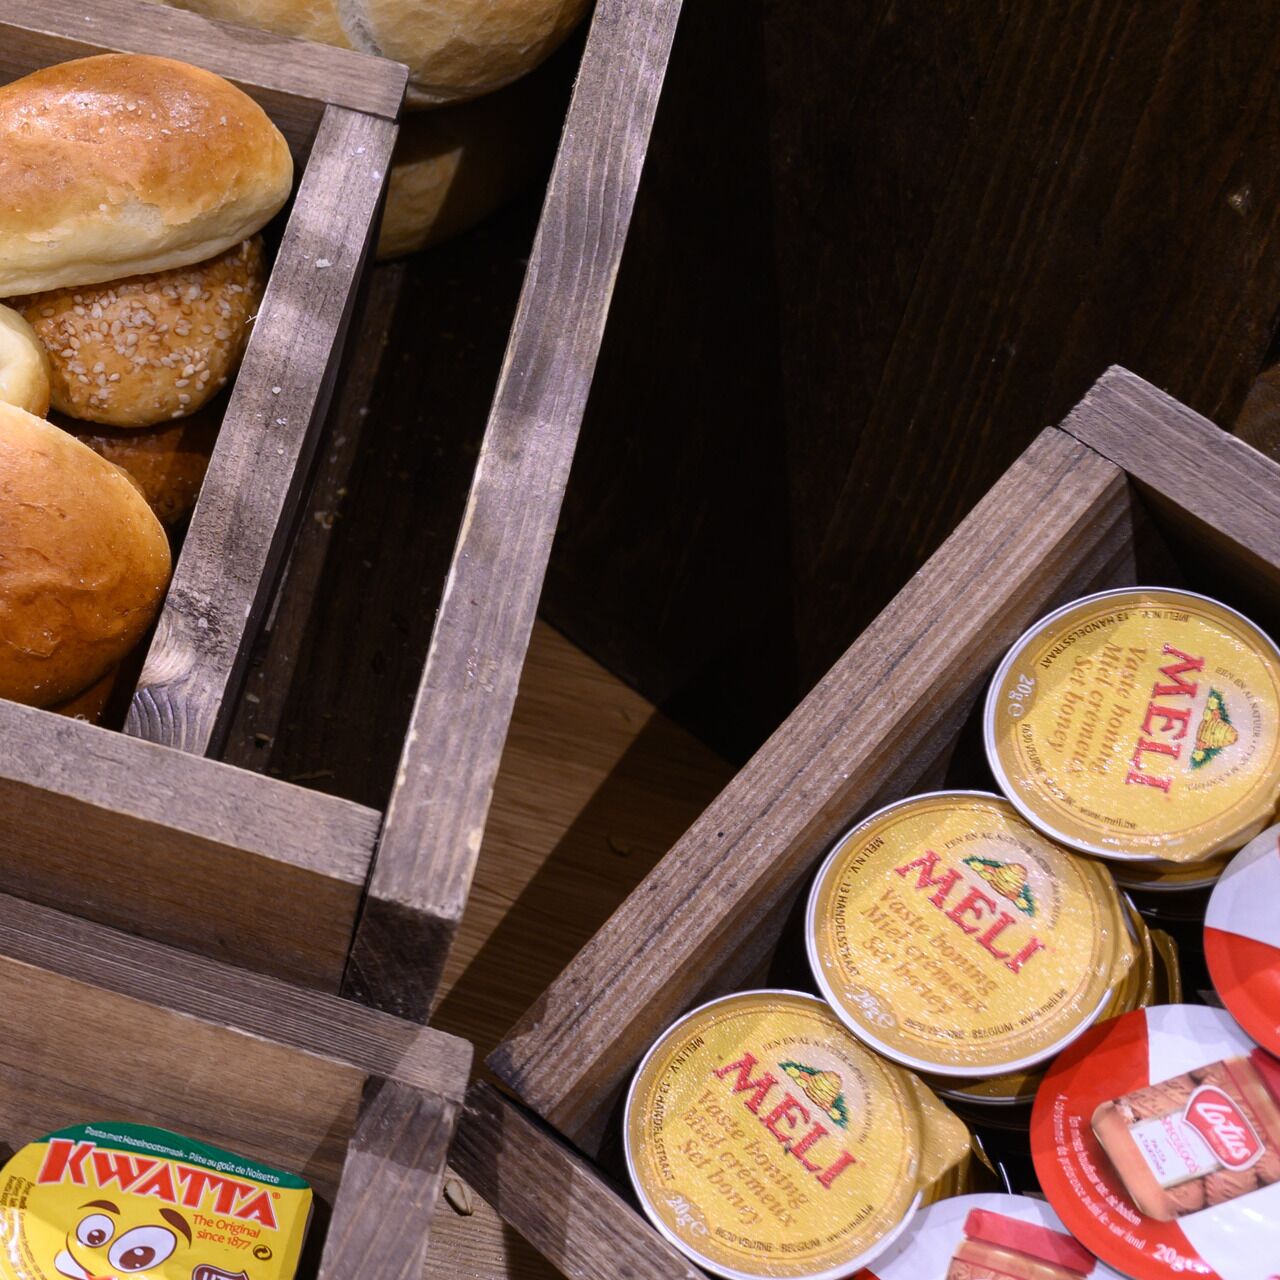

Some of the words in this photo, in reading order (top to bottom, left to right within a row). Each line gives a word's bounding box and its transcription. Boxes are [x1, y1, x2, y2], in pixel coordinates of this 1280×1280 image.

[1069, 655, 1092, 686] Set
[1124, 642, 1206, 794] MELI
[894, 849, 1046, 975] MELI
[712, 1051, 857, 1190] MELI
[1195, 1101, 1252, 1160] Lotus
[37, 1137, 280, 1232] KWATTA
[85, 1126, 107, 1138] Pasta
[108, 1133, 123, 1143] met
[123, 1135, 184, 1158] Hazelnootsmaak
[188, 1152, 208, 1166] Pâte
[216, 1160, 235, 1171] goût
[235, 1164, 246, 1176] de
[245, 1167, 280, 1184] Noisette
[193, 1213, 214, 1227] The
[216, 1218, 261, 1239] Original
[196, 1228, 225, 1243] since
[227, 1236, 252, 1249] 1877
